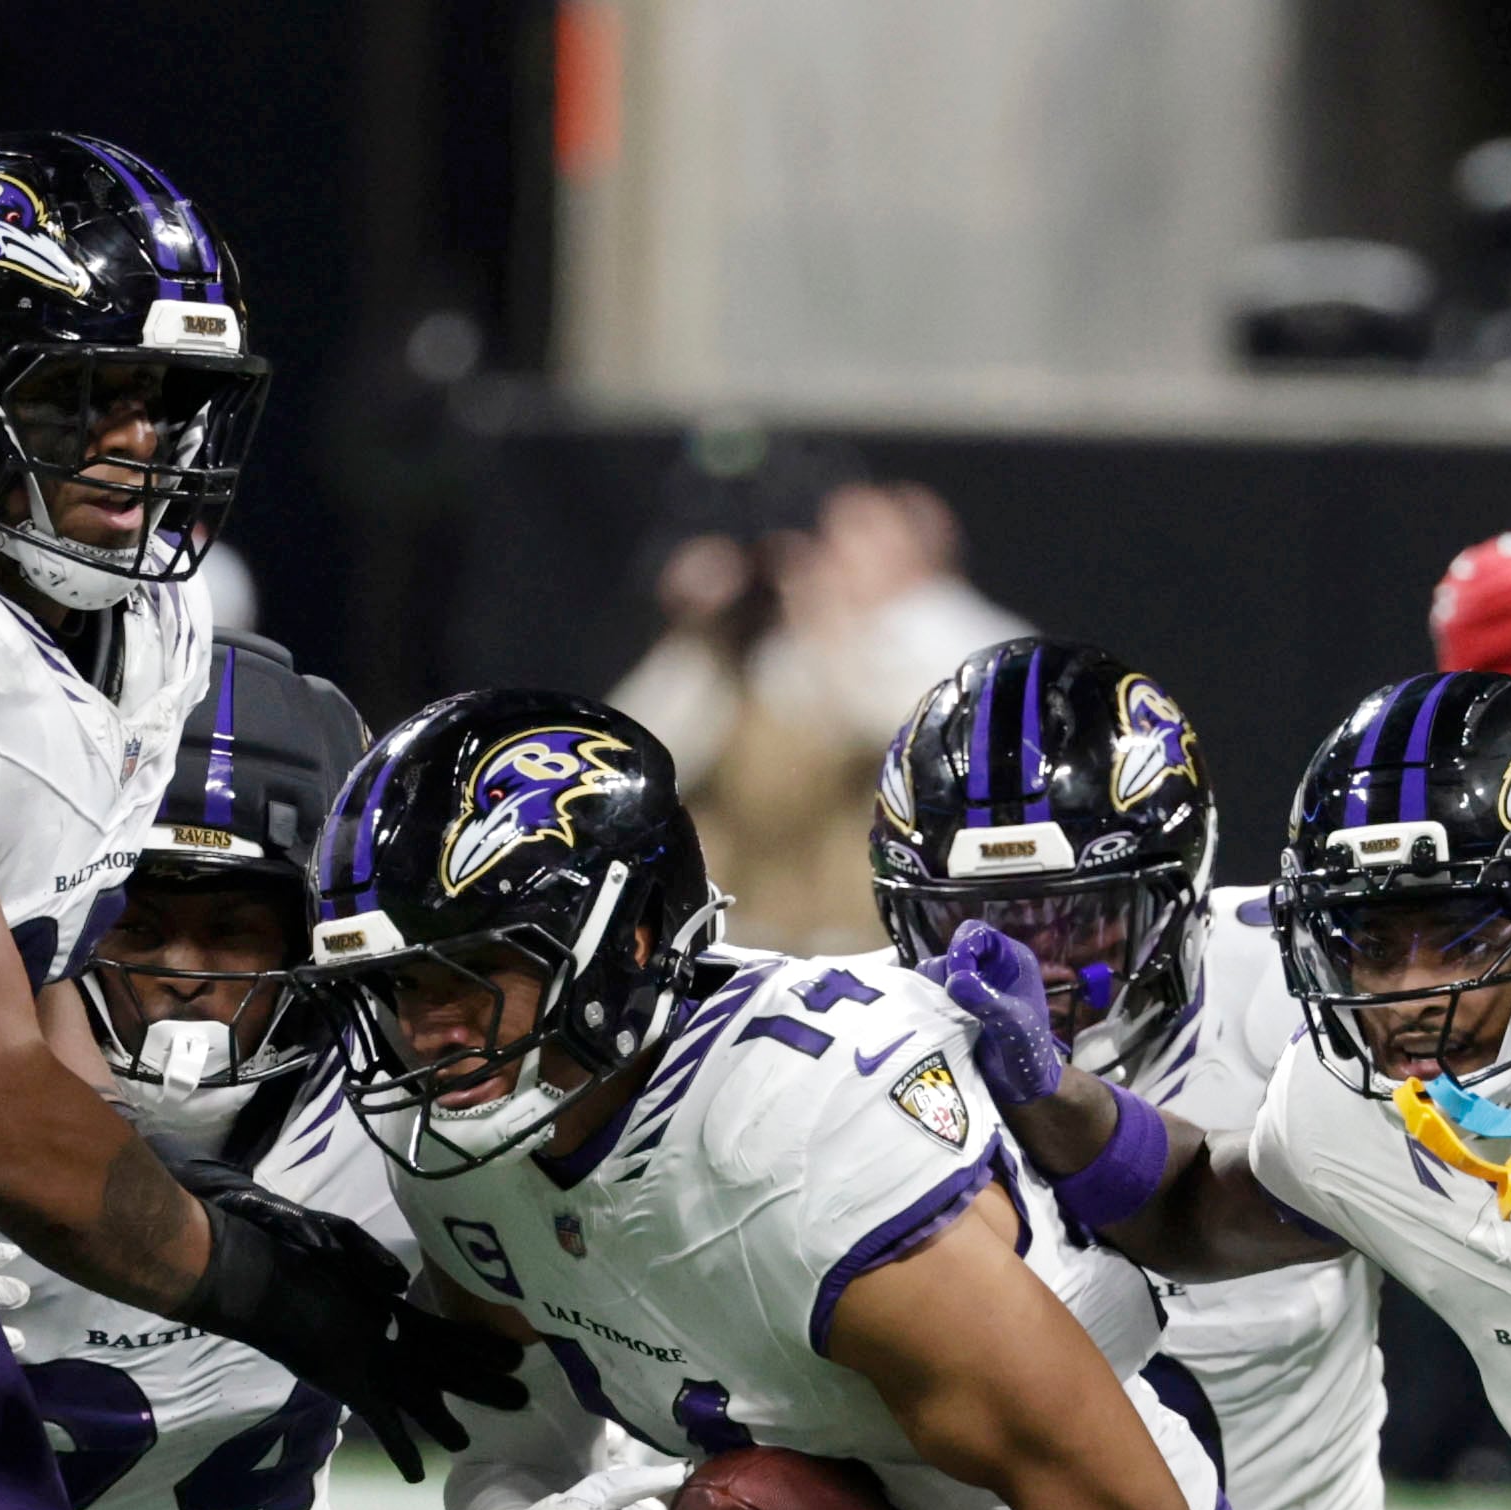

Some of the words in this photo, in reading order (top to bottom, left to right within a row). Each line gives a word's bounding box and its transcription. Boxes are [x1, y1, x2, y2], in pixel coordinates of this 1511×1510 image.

[172, 827, 233, 849] RAVENS
[980, 840, 1037, 858] RAVENS
[1359, 837, 1401, 853] RAVENS
[55, 852, 140, 893] BALTIMOR
[893, 1054, 942, 1095] RAVENS
[85, 1326, 208, 1350] BALTI
